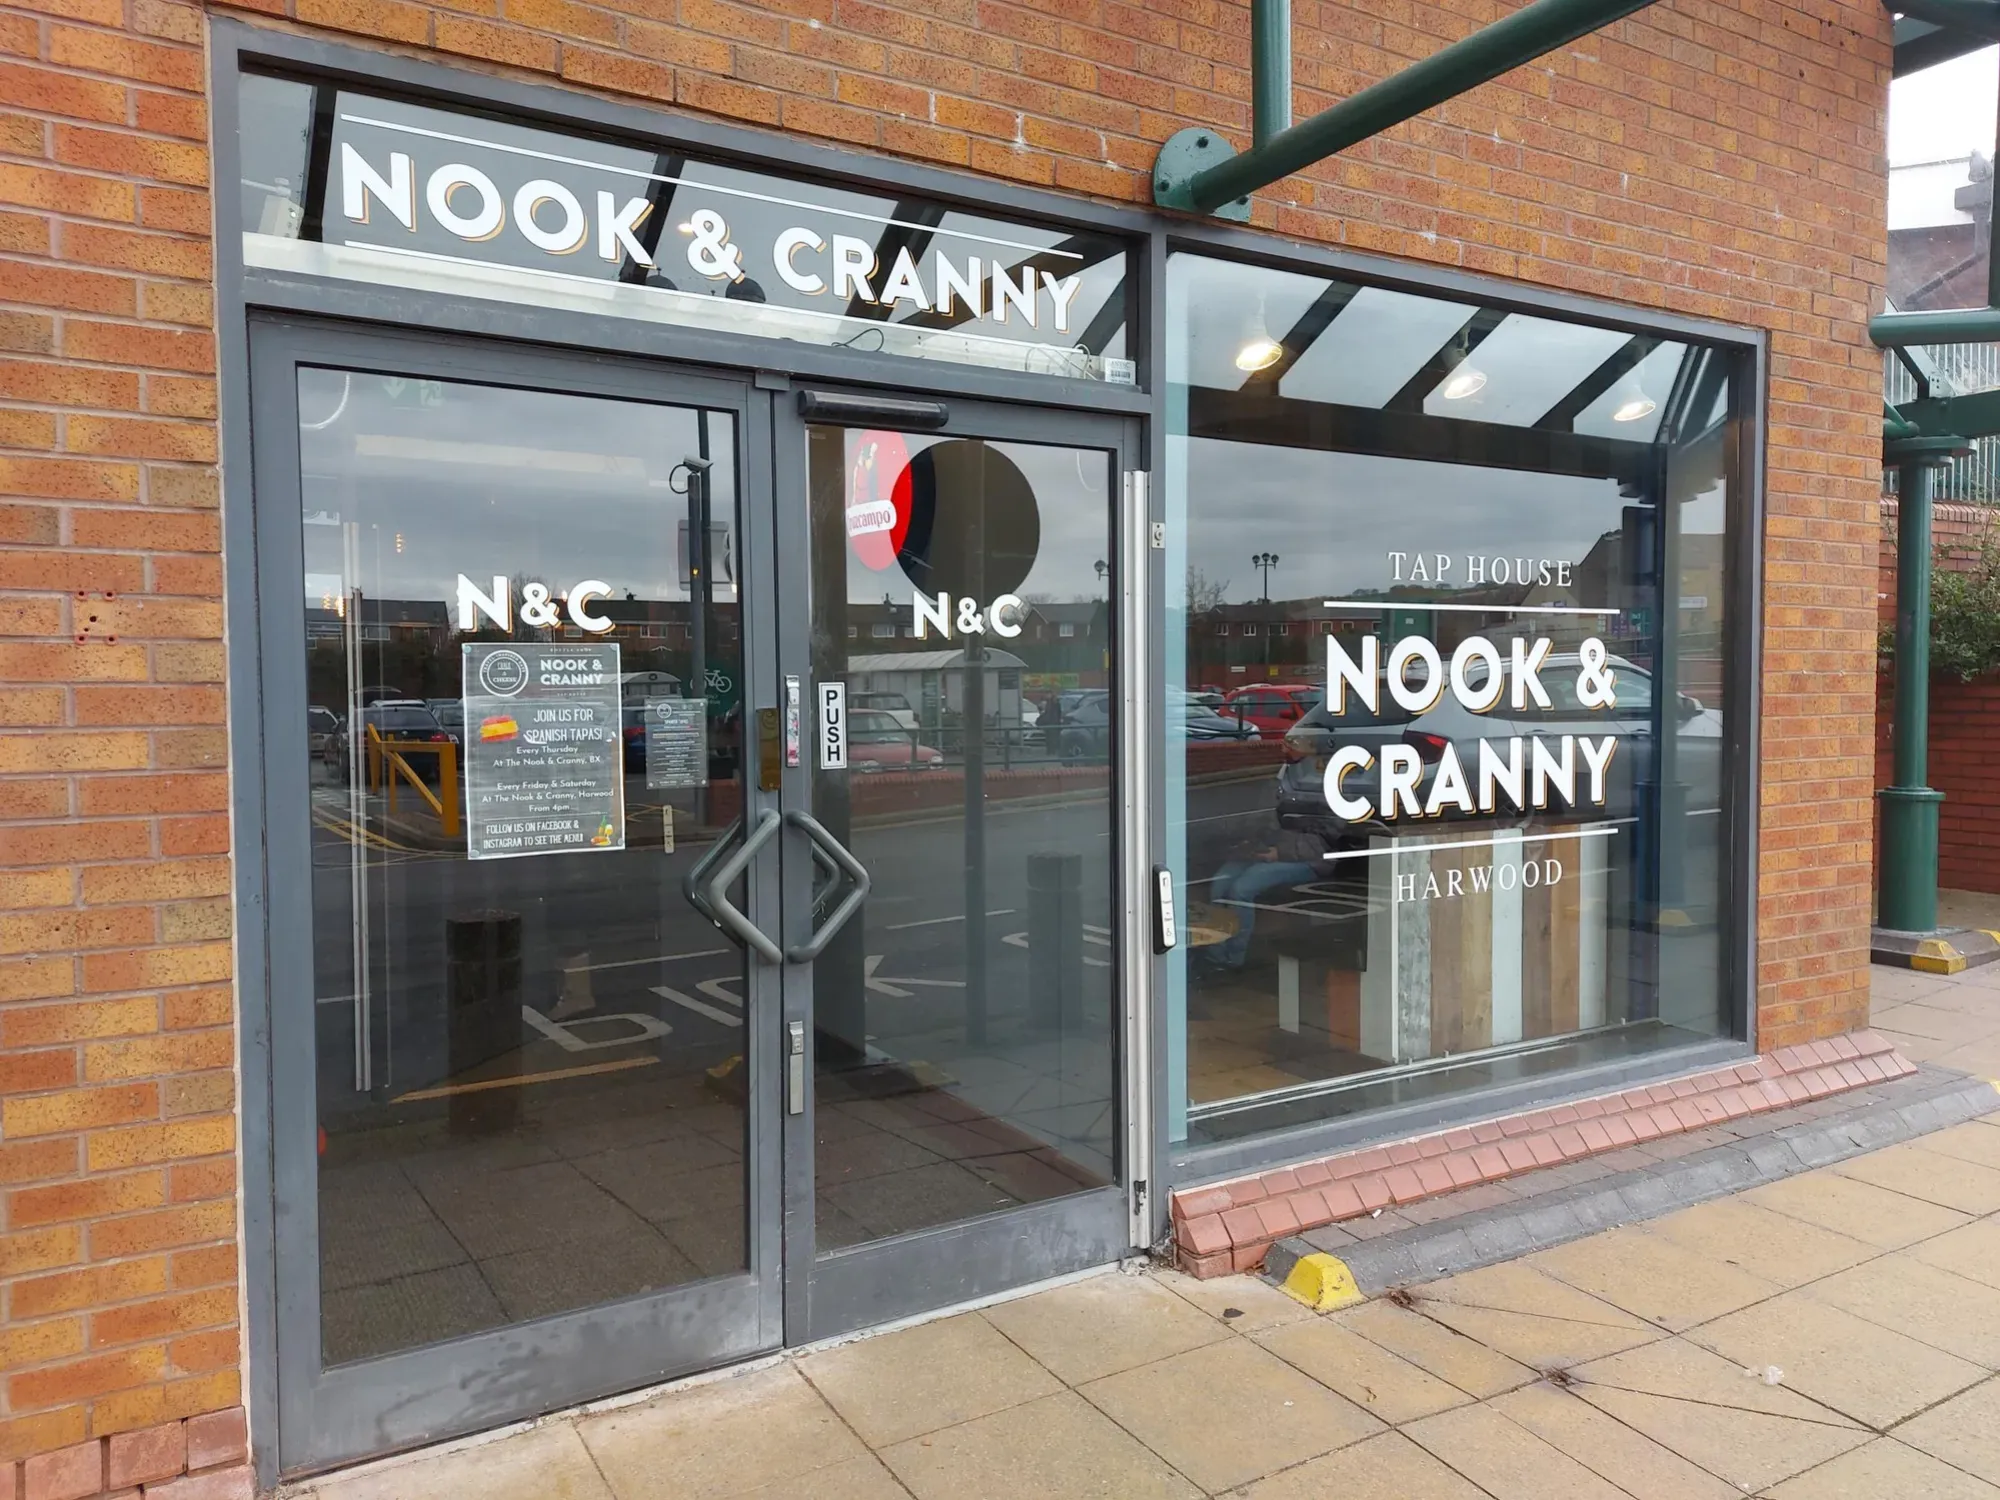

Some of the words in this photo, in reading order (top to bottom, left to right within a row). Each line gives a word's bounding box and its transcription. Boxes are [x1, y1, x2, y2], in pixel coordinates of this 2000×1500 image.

[340, 141, 655, 270] NOOK
[683, 208, 743, 283] &
[773, 226, 1082, 333] CRANNY
[1388, 552, 1452, 582] TAP
[1466, 555, 1573, 588] HOUSE
[456, 573, 616, 634] N&C
[913, 591, 1023, 640] N&C
[540, 658, 588, 671] NOOK
[592, 658, 603, 671] &
[540, 673, 603, 686] CRANNY
[1326, 634, 1554, 716] NOOK
[1575, 637, 1618, 710] &
[533, 709, 556, 723] JOIN
[559, 709, 572, 722] US
[574, 708, 594, 721] FOR
[826, 690, 840, 761] PUSH
[525, 729, 567, 742] SPANISH
[516, 746, 539, 755] Every
[541, 745, 578, 753] Thursday
[493, 759, 503, 767] At
[506, 759, 520, 767] The
[523, 757, 545, 766] Nook
[547, 757, 554, 765] &
[497, 782, 520, 791] Every
[522, 780, 549, 790] Friday
[550, 780, 558, 788] &
[560, 779, 596, 788] Saturday
[1323, 735, 1618, 823] CRANNY
[482, 795, 492, 803] At
[494, 794, 509, 802] The
[512, 792, 534, 801] Nook
[536, 792, 543, 800] &
[578, 788, 614, 798] Harwood
[529, 804, 550, 812] From
[552, 804, 570, 812] 4pm
[486, 824, 512, 835] FOLLOW
[514, 823, 524, 833] US
[525, 822, 536, 832] ON
[537, 820, 573, 831] FACEBOOK
[573, 820, 580, 829] &
[483, 837, 522, 849] INSTAGRAM
[523, 836, 534, 846] TO
[534, 835, 548, 845] SEE
[549, 834, 563, 845] THE
[1396, 859, 1563, 903] HARWOOD
